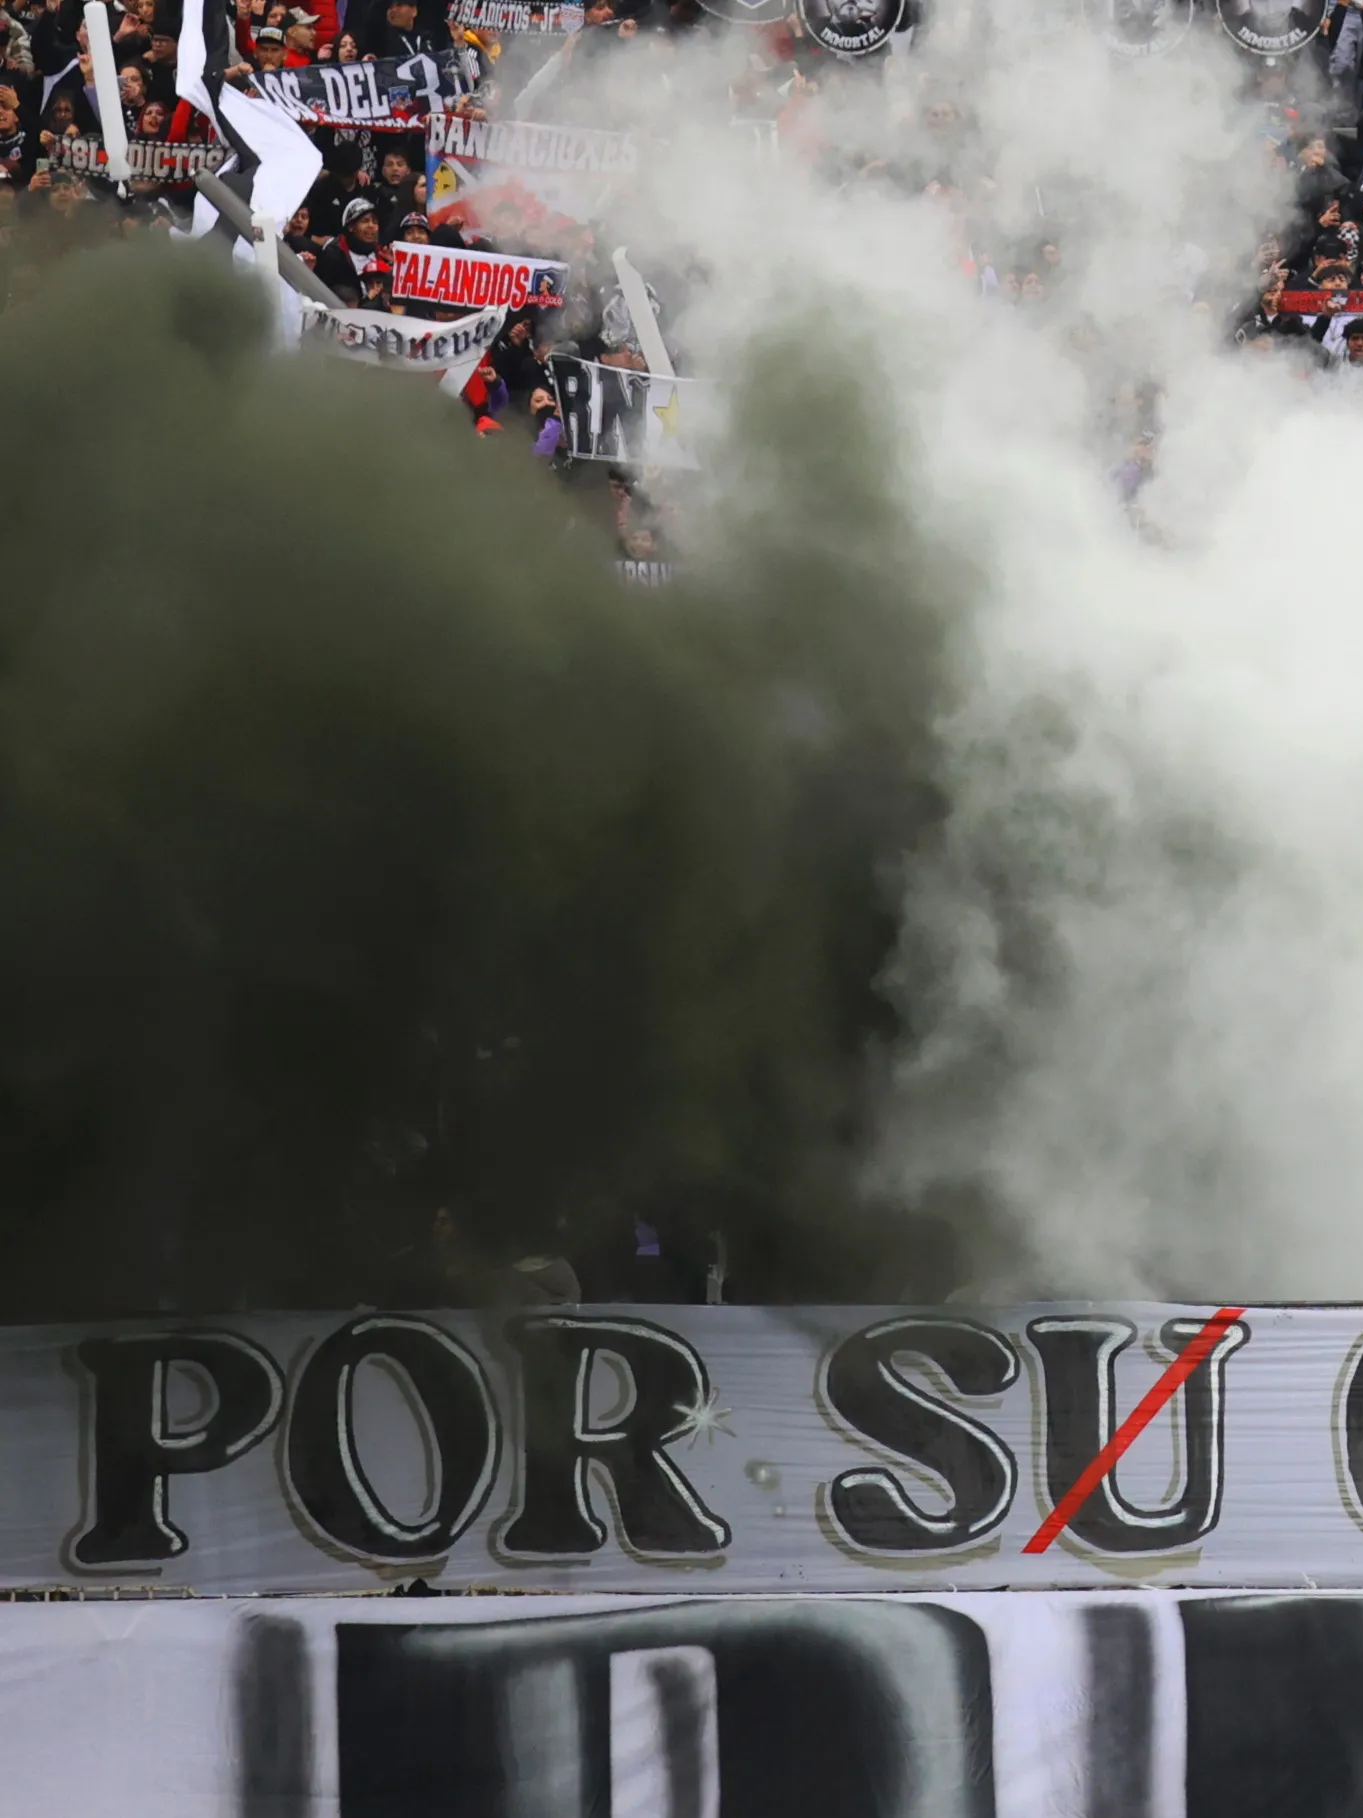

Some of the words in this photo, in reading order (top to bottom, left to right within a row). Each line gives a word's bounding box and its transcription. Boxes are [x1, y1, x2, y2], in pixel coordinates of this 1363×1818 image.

[819, 26, 885, 50] IMMORTAL
[1236, 25, 1308, 50] IMMORTAL
[319, 61, 391, 120] DEL
[391, 249, 530, 312] TALAINDIOS
[63, 1314, 732, 1578] POR
[815, 1312, 1250, 1572] SU
